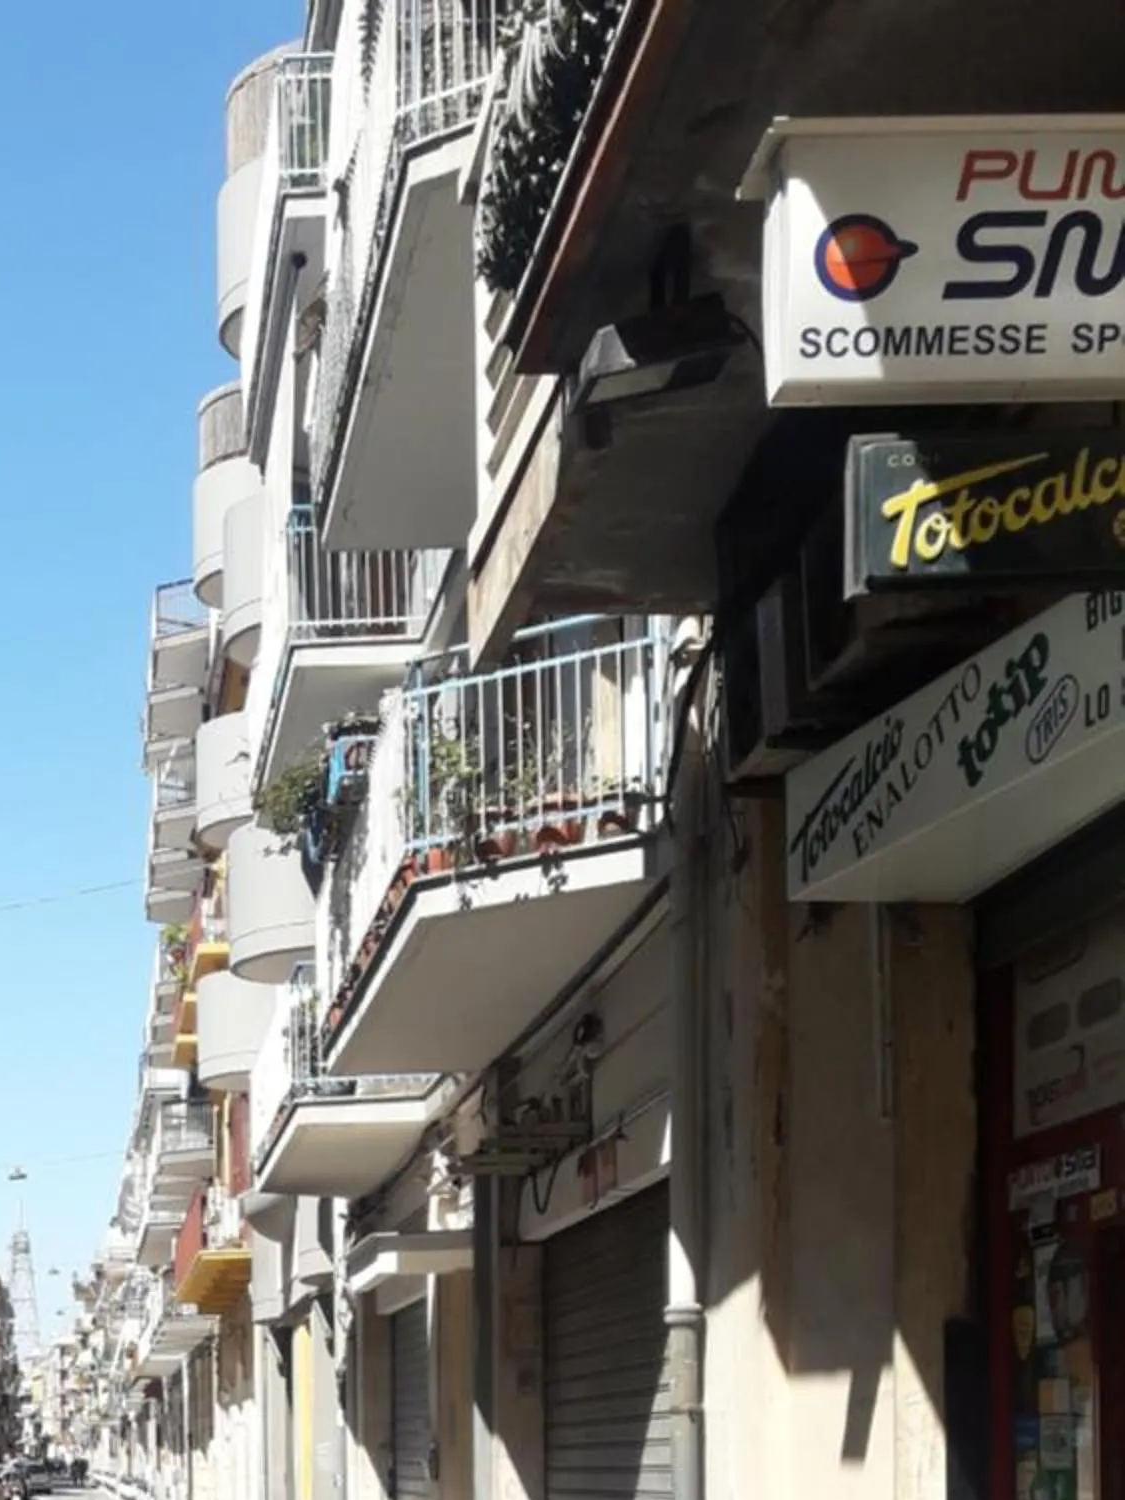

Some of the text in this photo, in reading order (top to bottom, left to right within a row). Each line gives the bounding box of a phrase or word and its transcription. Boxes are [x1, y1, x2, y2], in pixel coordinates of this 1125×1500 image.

[799, 324, 1048, 359] SCOMMESSE
[880, 447, 1125, 568] Totocalc
[851, 660, 982, 859] ENALOTTO
[956, 631, 1050, 788] totip
[789, 713, 906, 883] Totocalcio
